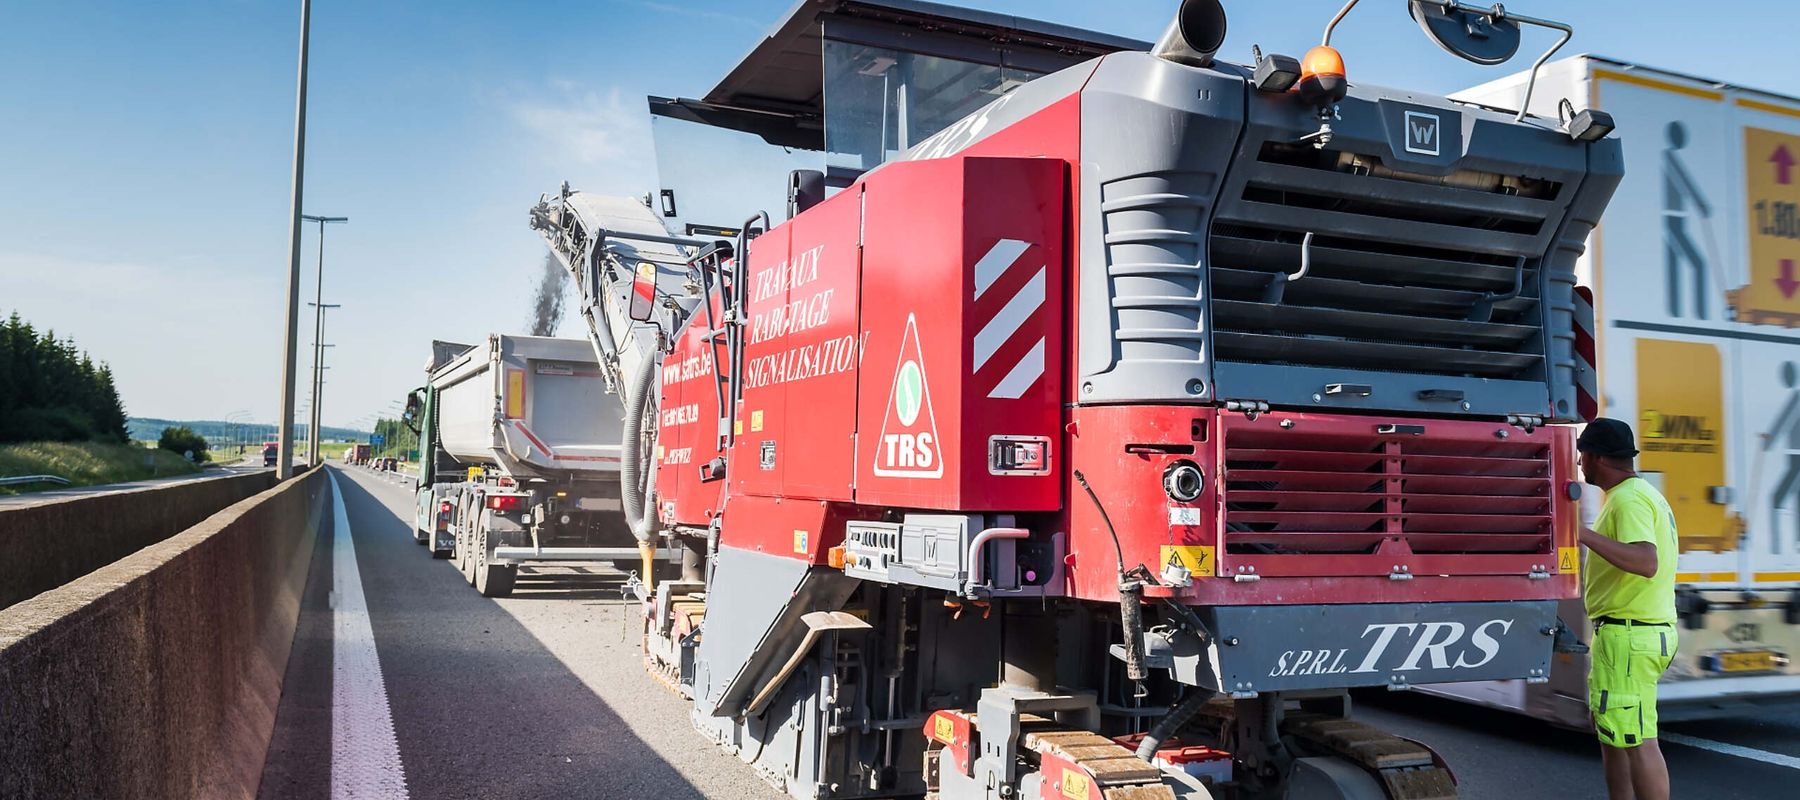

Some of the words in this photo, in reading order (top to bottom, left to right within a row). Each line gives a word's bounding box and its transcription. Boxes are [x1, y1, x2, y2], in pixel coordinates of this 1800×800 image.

[1410, 121, 1435, 145] W
[754, 245, 824, 304] TRAVAUX
[749, 288, 834, 346] RABOTAGE
[744, 331, 869, 390] SIGNALISATION
[885, 431, 933, 468] TRS
[1268, 648, 1349, 677] S.P.R.L.
[1349, 618, 1515, 674] TRS
